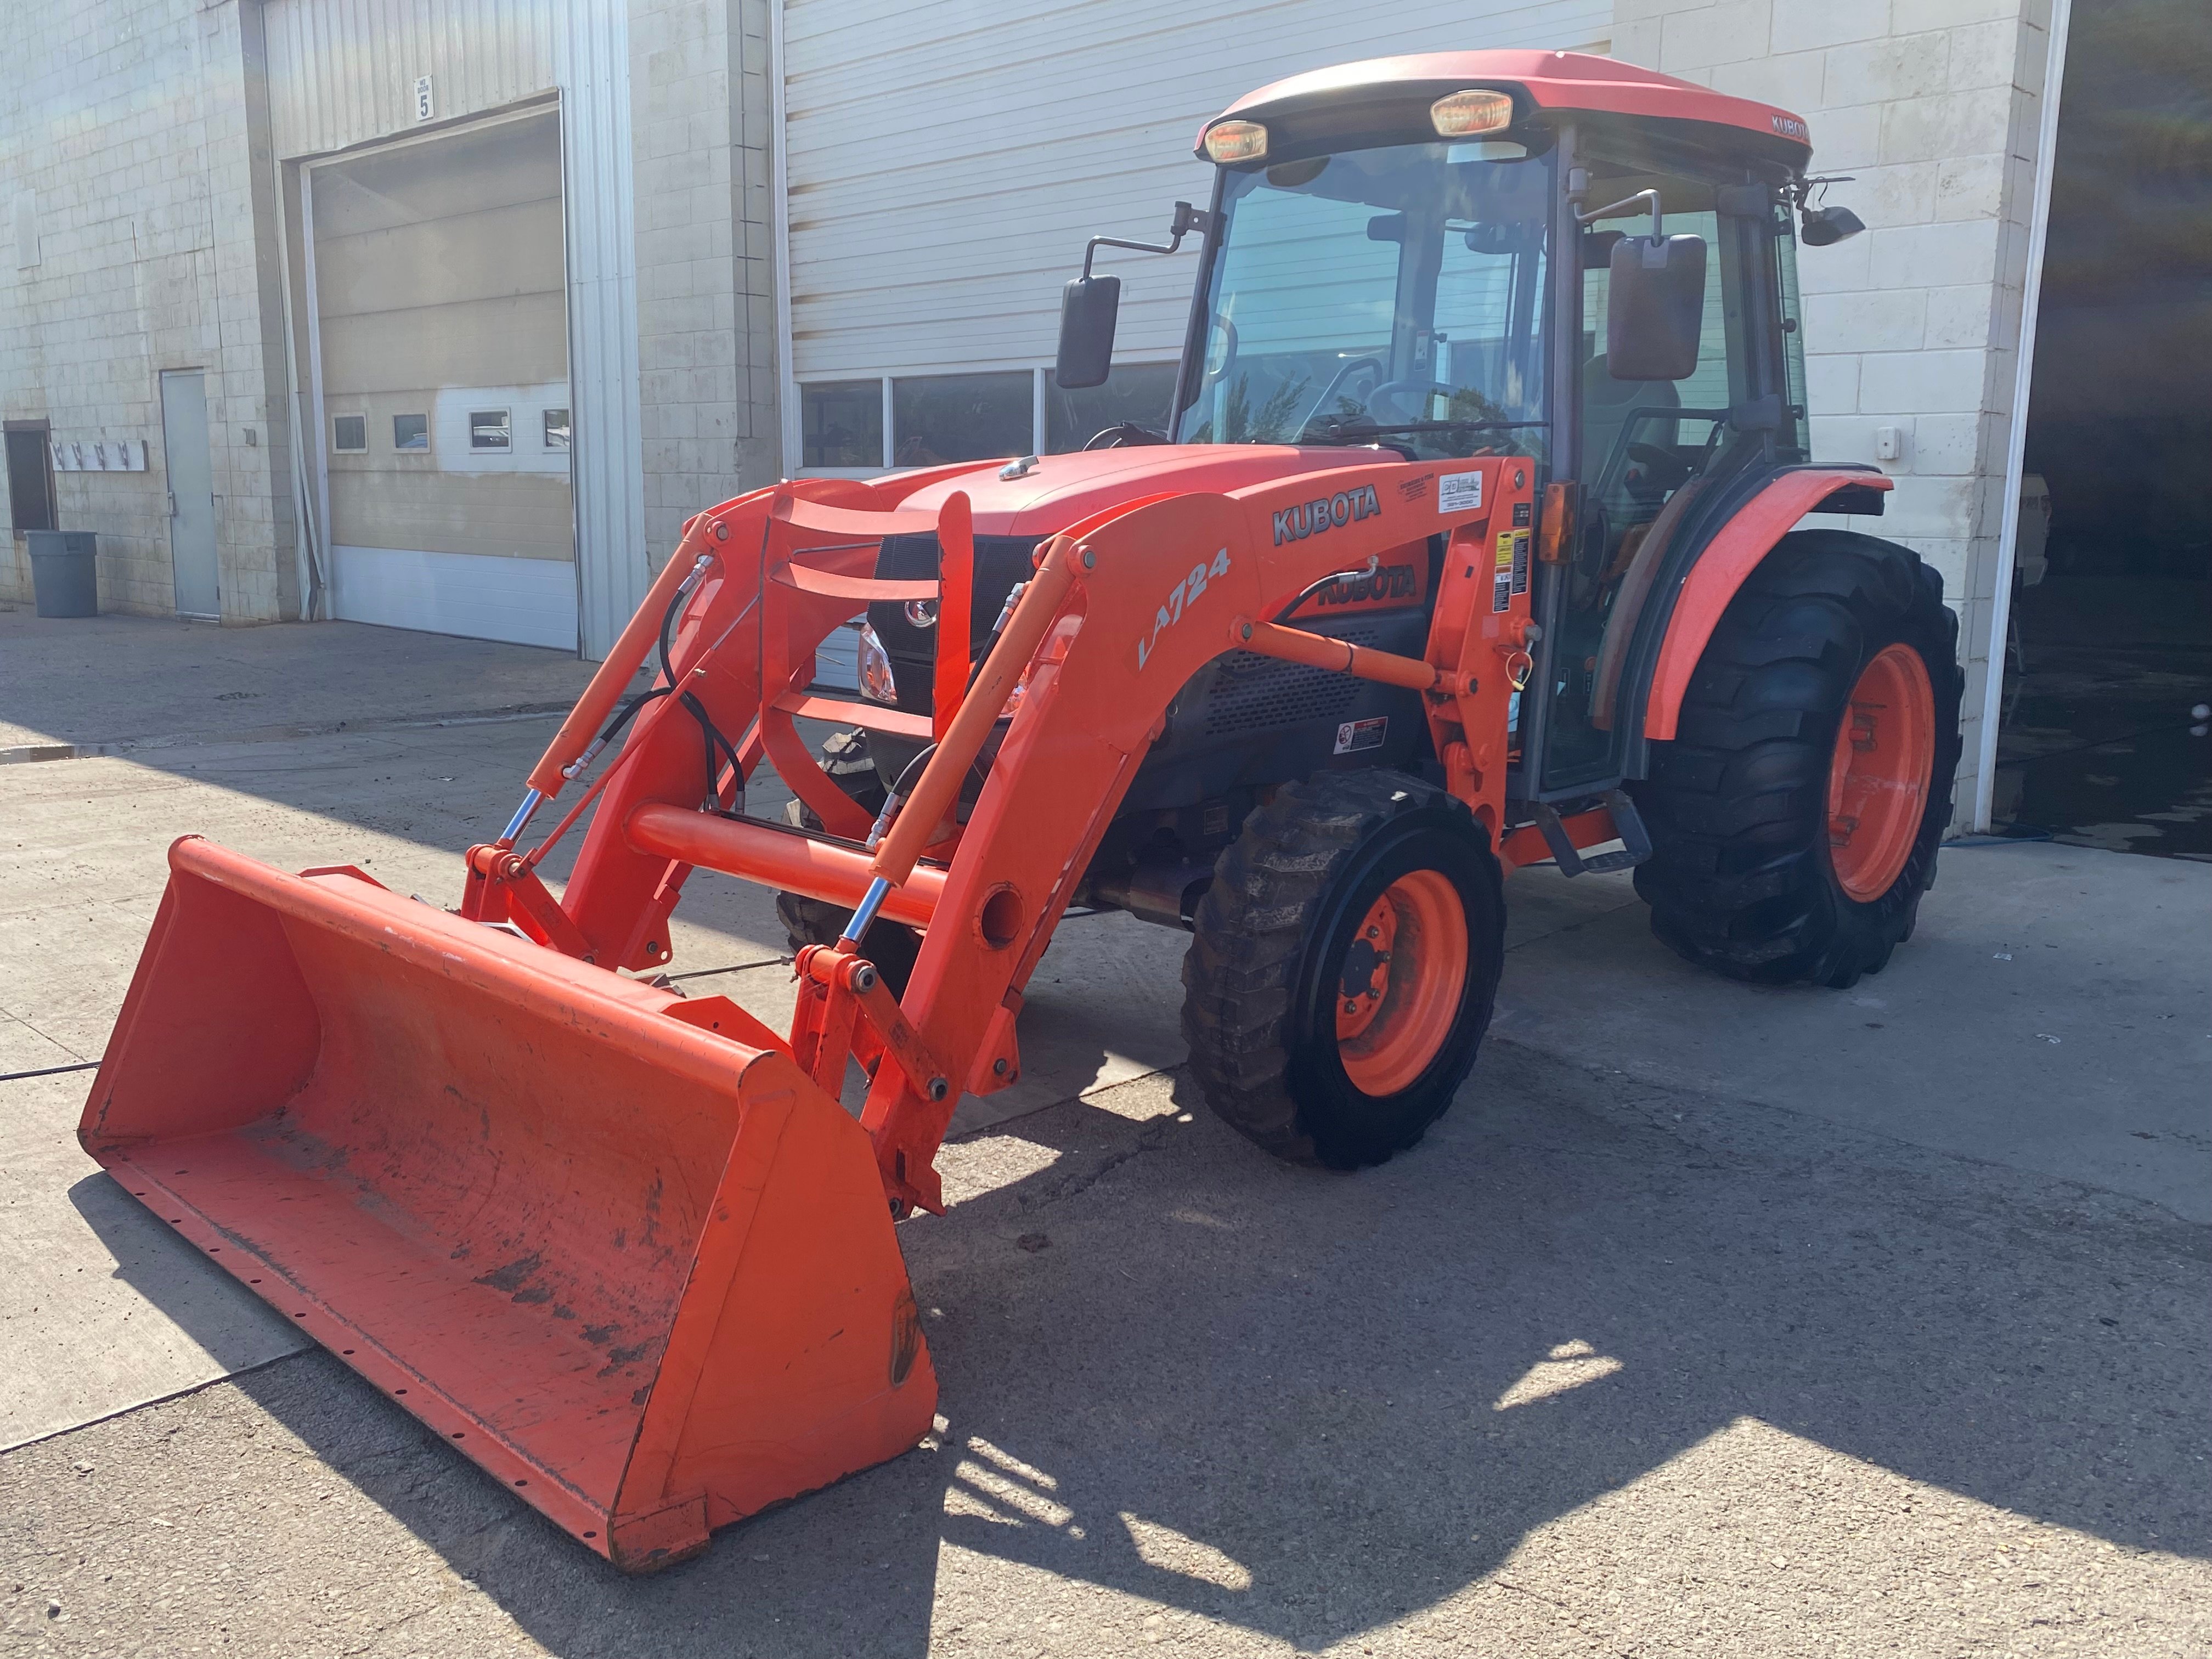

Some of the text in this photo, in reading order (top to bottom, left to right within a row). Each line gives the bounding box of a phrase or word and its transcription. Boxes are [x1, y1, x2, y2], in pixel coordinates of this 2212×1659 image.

[417, 84, 429, 94] DOOR
[420, 94, 428, 117] 5
[1273, 484, 1381, 546] KUBOTA
[1138, 547, 1231, 672] LA724
